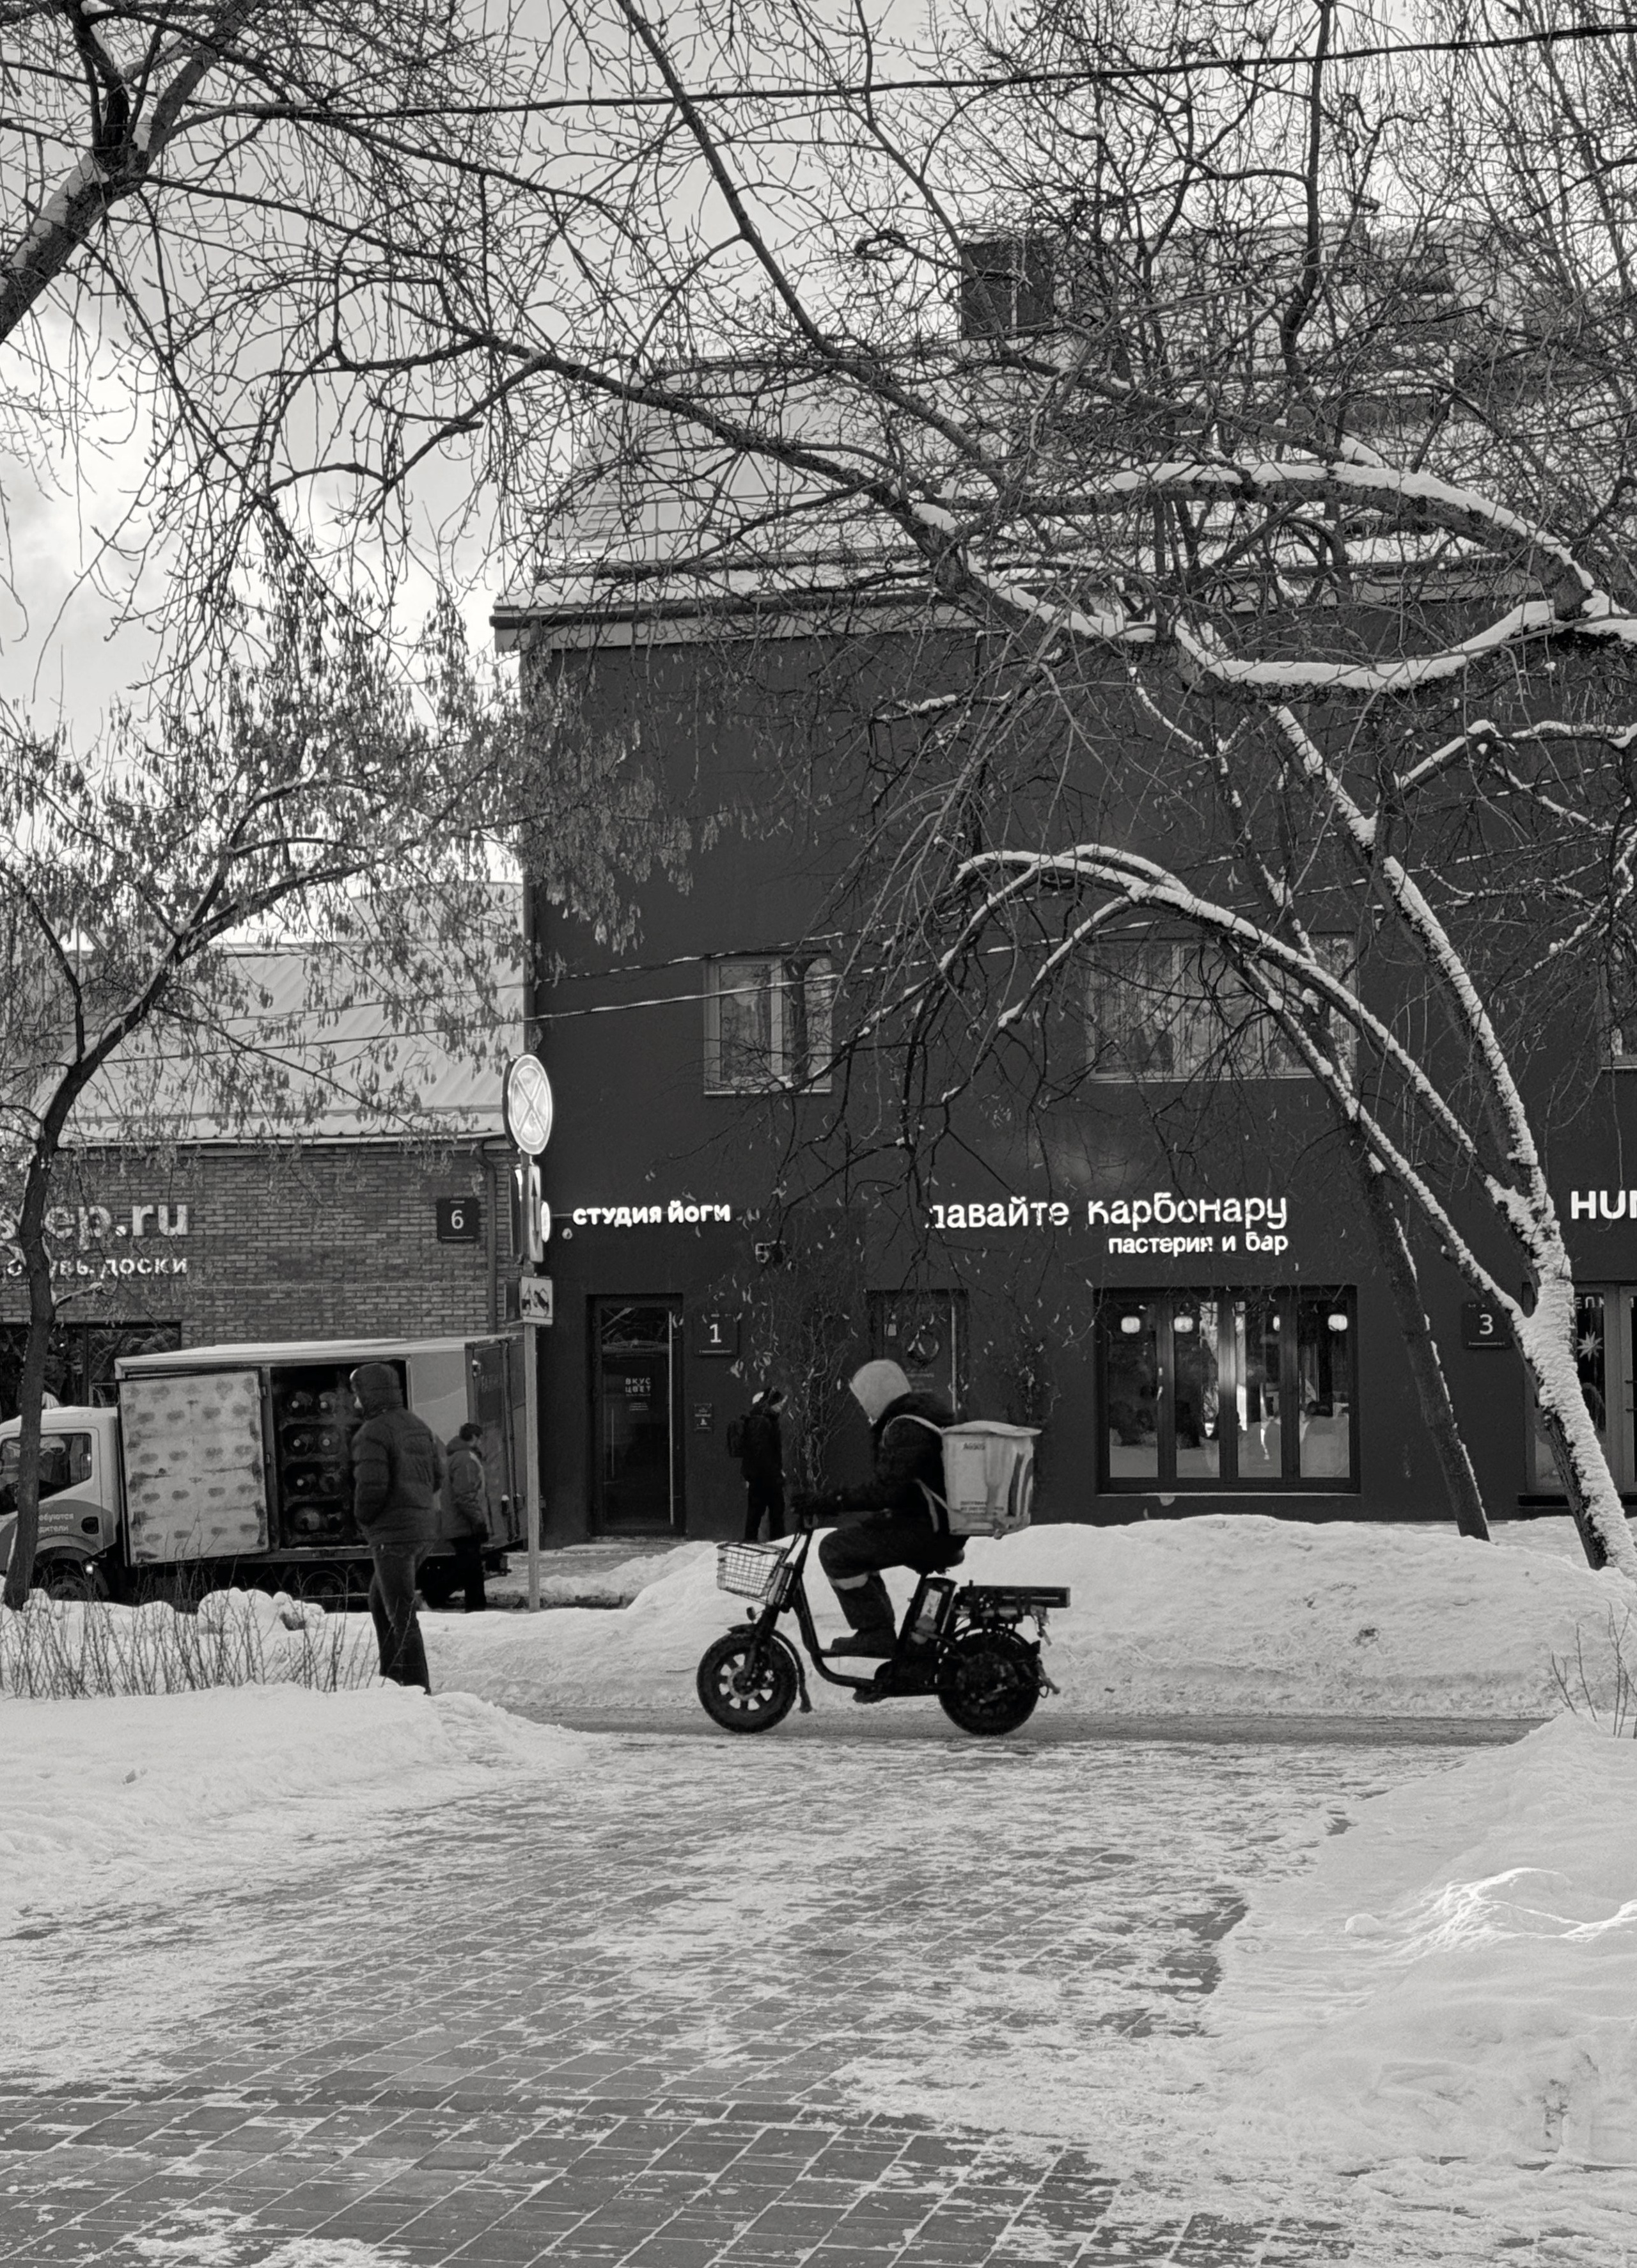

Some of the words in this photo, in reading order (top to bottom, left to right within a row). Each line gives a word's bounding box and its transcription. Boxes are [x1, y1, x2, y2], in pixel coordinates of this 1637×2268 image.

[451, 1209, 464, 1229] 6
[1088, 1192, 1287, 1232] карбонару
[1221, 1235, 1236, 1252] и
[1245, 1231, 1288, 1256] бар
[709, 1323, 722, 1343] 1
[1479, 1313, 1493, 1335] 3
